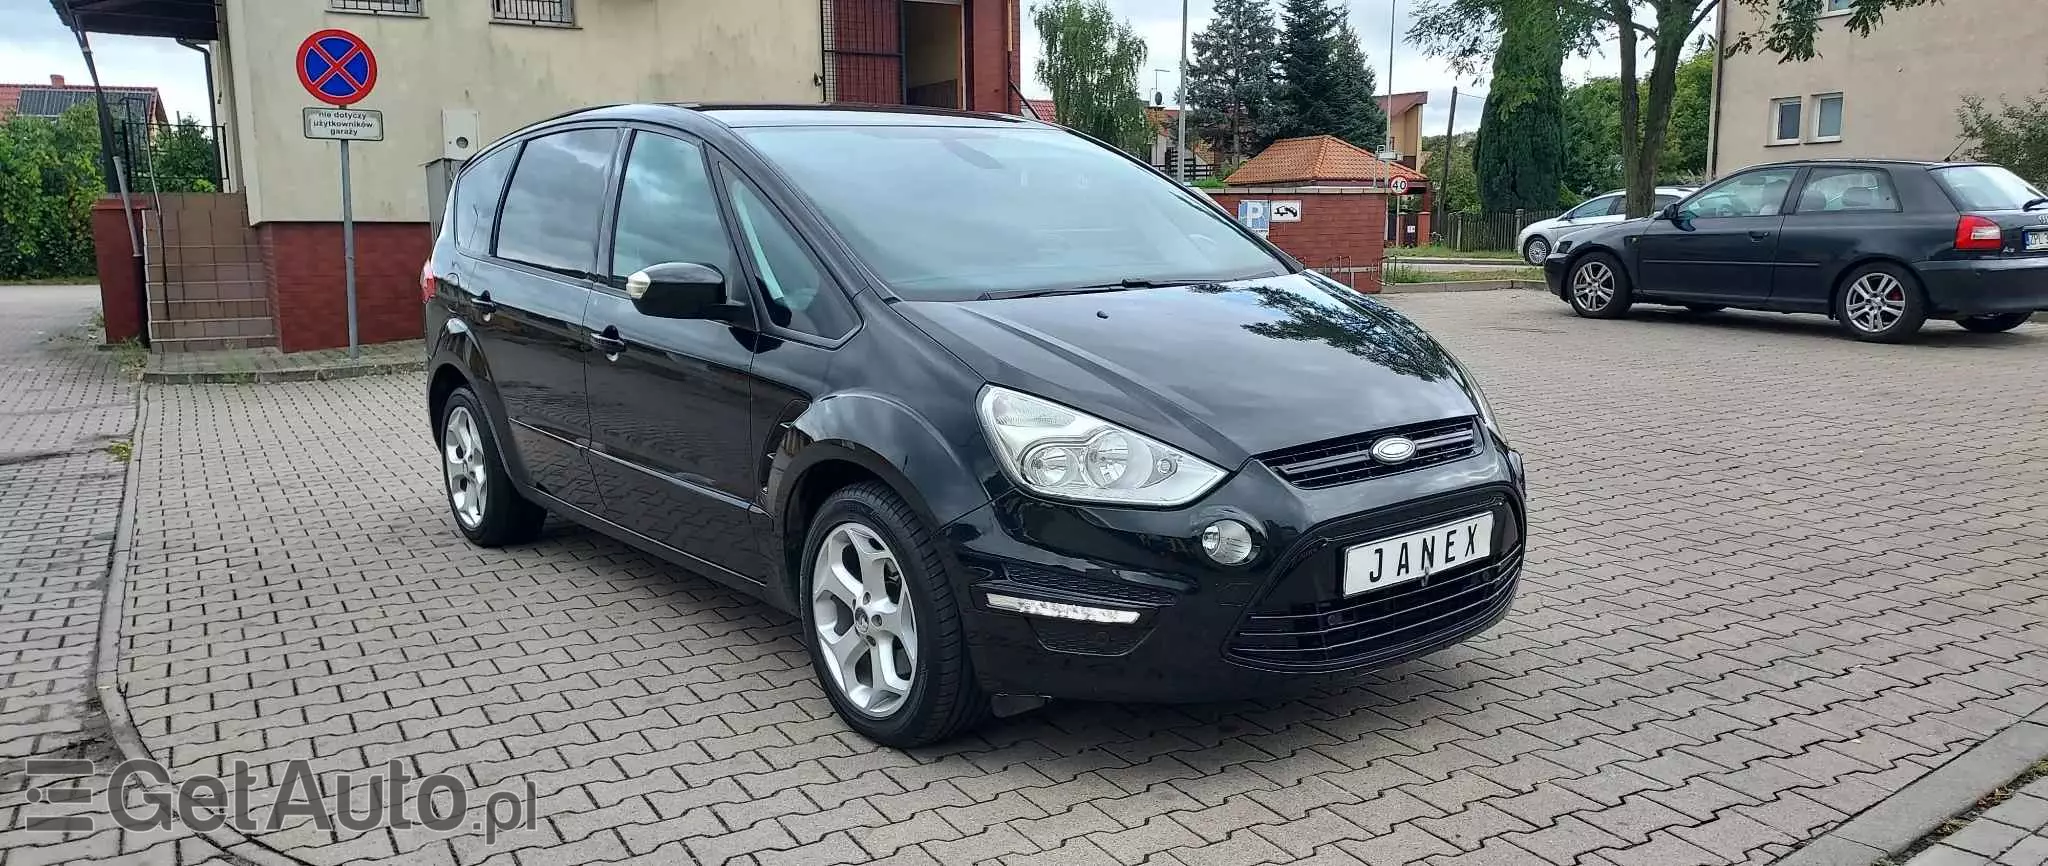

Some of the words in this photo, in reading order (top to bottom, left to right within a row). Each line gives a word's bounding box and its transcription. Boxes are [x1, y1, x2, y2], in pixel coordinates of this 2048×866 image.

[333, 111, 367, 120] dotyczy
[313, 120, 373, 128] użytkowników
[330, 128, 358, 136] garaży
[1392, 180, 1407, 190] 40
[1247, 202, 1264, 229] P
[1369, 524, 1477, 583] JANEX
